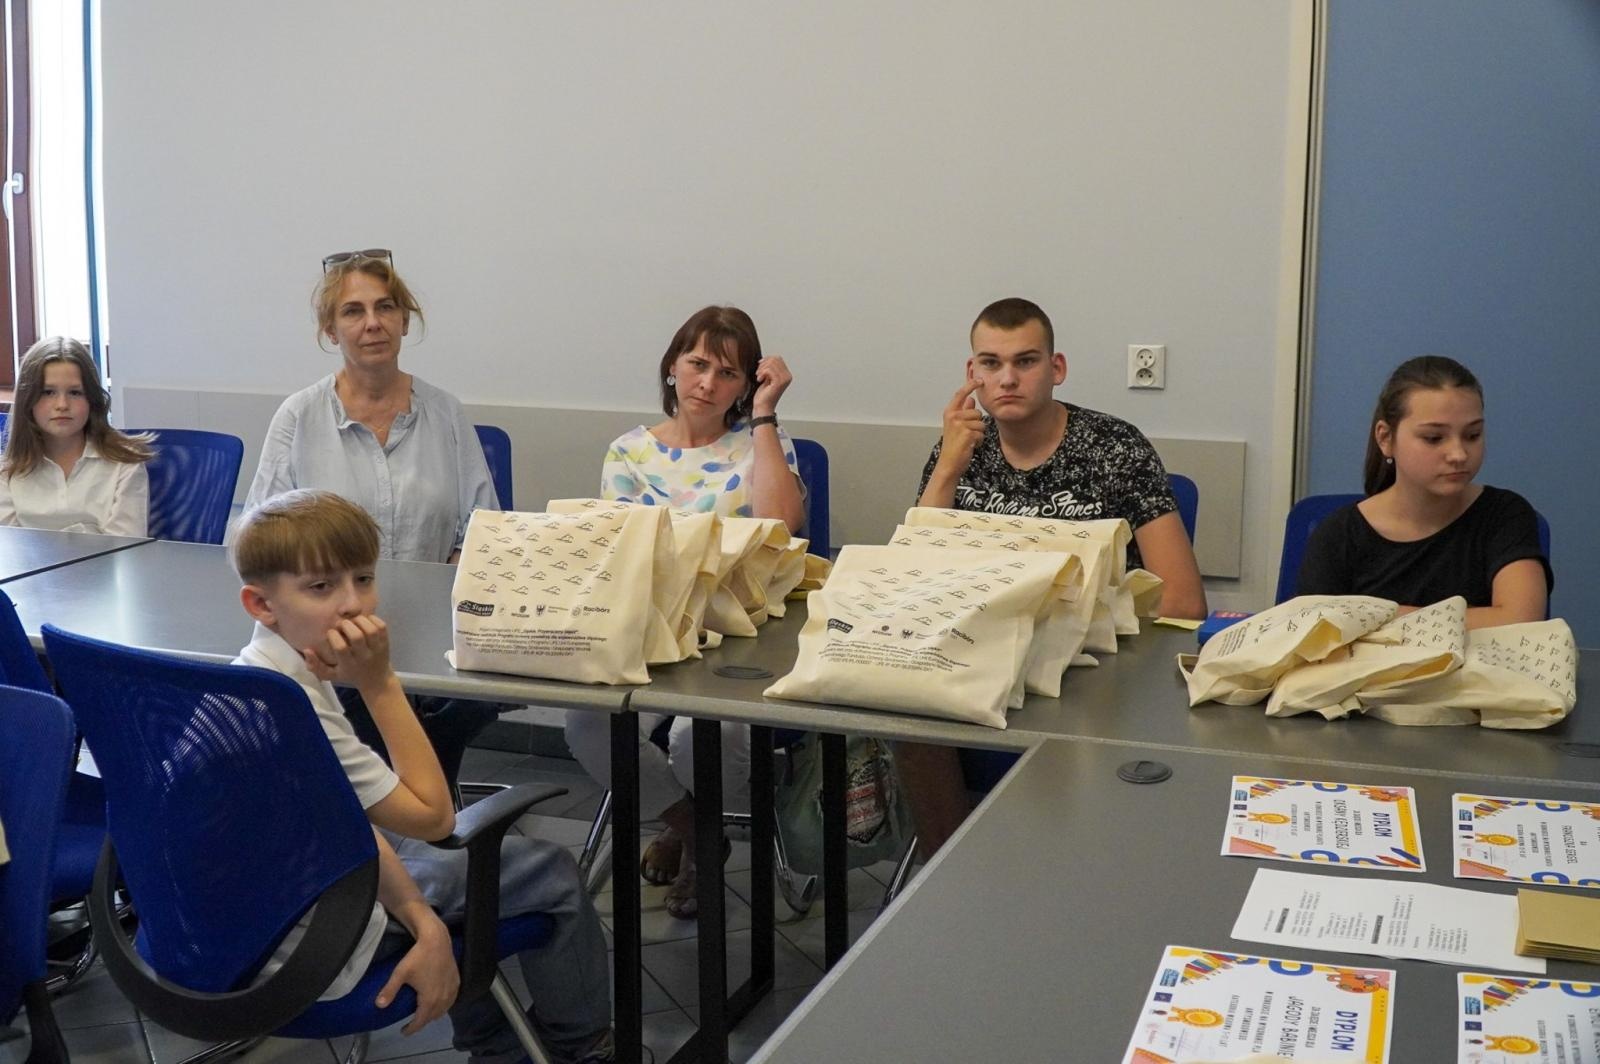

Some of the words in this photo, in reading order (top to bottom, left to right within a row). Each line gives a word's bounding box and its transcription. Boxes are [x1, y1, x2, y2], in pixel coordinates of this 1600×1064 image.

[956, 485, 986, 508] The
[984, 491, 1039, 517] Rolling
[1041, 490, 1103, 517] Stones
[1372, 812, 1393, 838] DYPLOM
[1283, 996, 1304, 1027] JAGODY
[1330, 1010, 1359, 1052] DYPLOM
